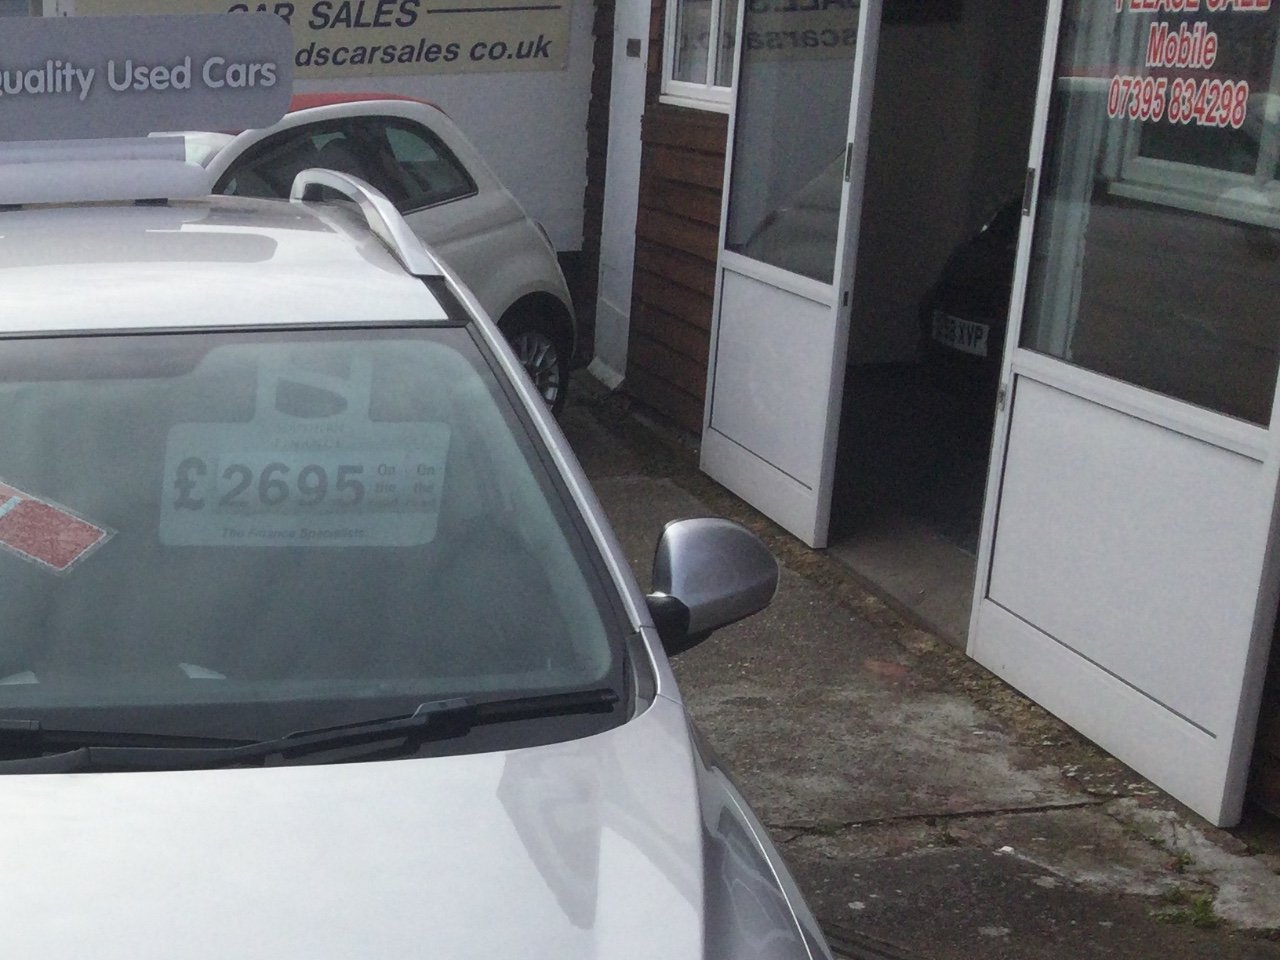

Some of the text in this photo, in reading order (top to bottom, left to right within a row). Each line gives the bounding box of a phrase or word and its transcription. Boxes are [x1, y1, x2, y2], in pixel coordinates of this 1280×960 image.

[308, 0, 418, 30] SALES
[1145, 21, 1218, 69] Mobile
[107, 55, 192, 91] Used
[201, 56, 277, 88] Cars
[1107, 75, 1250, 129] 07395 834298
